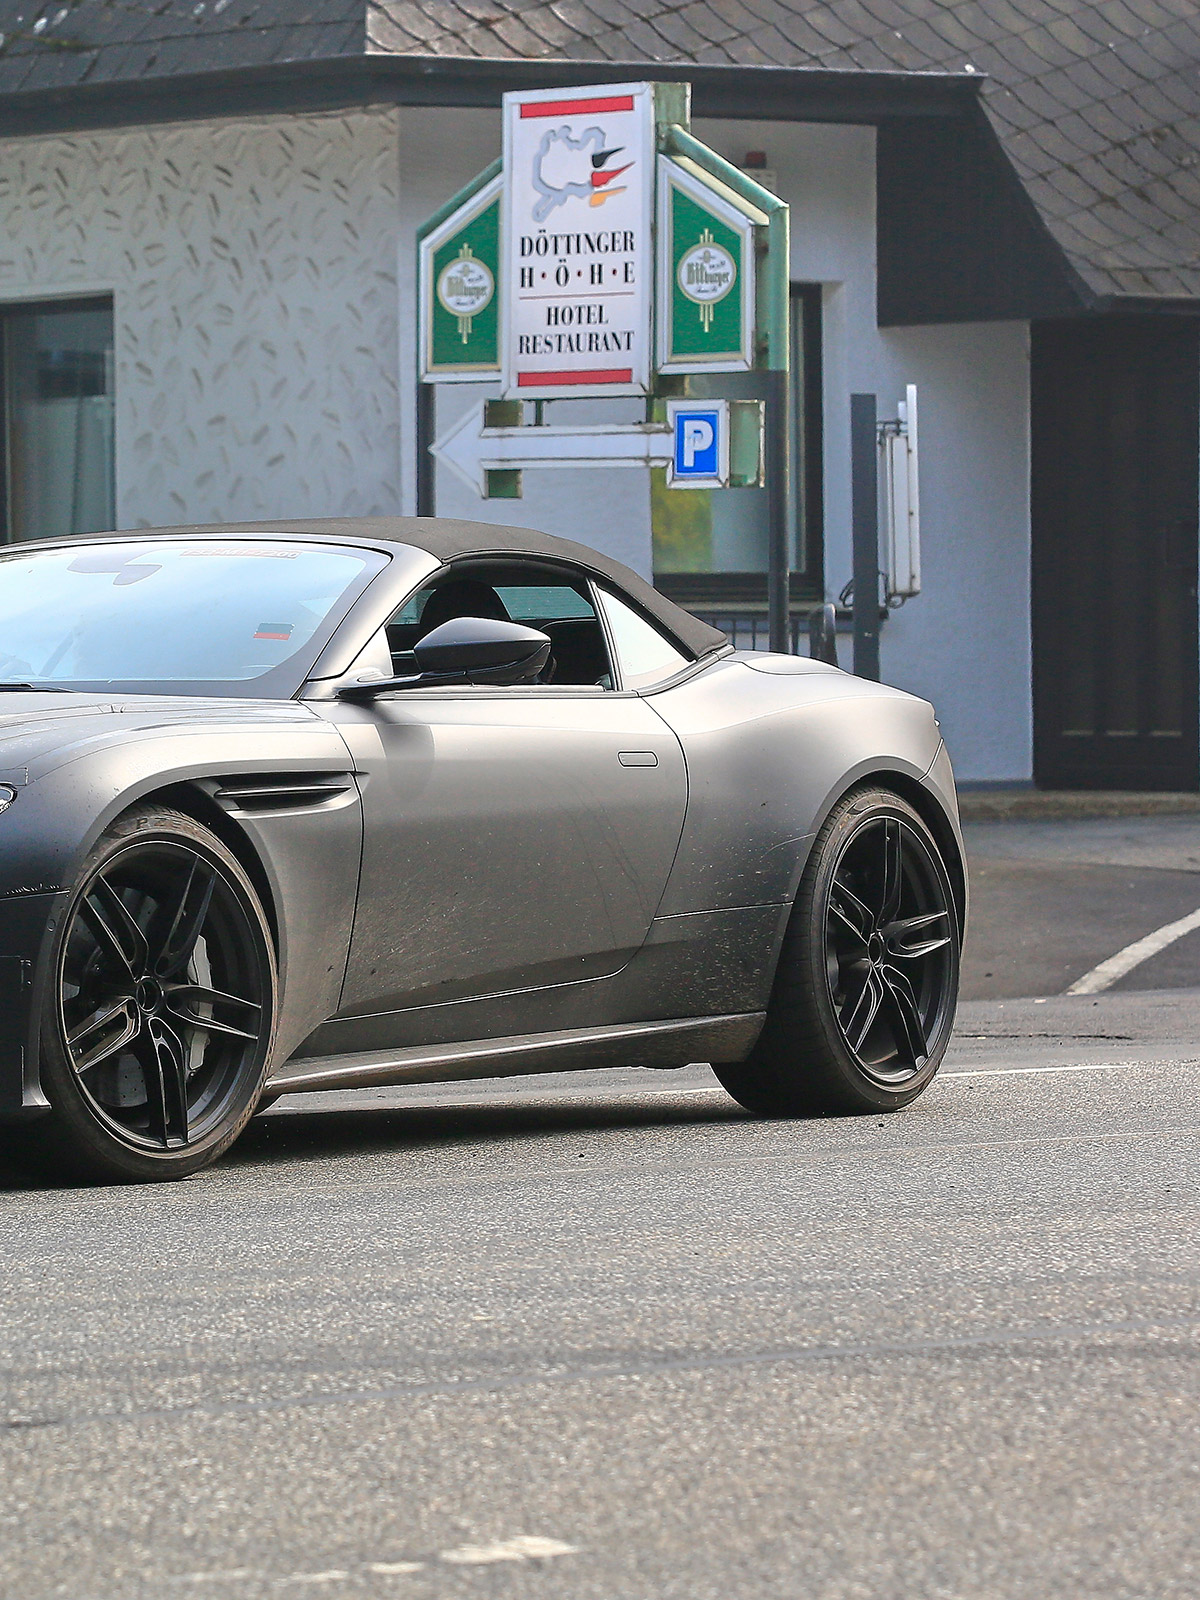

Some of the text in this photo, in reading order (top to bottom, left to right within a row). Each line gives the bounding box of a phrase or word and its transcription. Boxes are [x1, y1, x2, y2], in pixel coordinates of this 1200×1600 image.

[520, 229, 634, 257] DÖTTINGER
[547, 304, 609, 326] HOTEL
[519, 330, 634, 354] RESTAURANT
[684, 420, 714, 468] P
